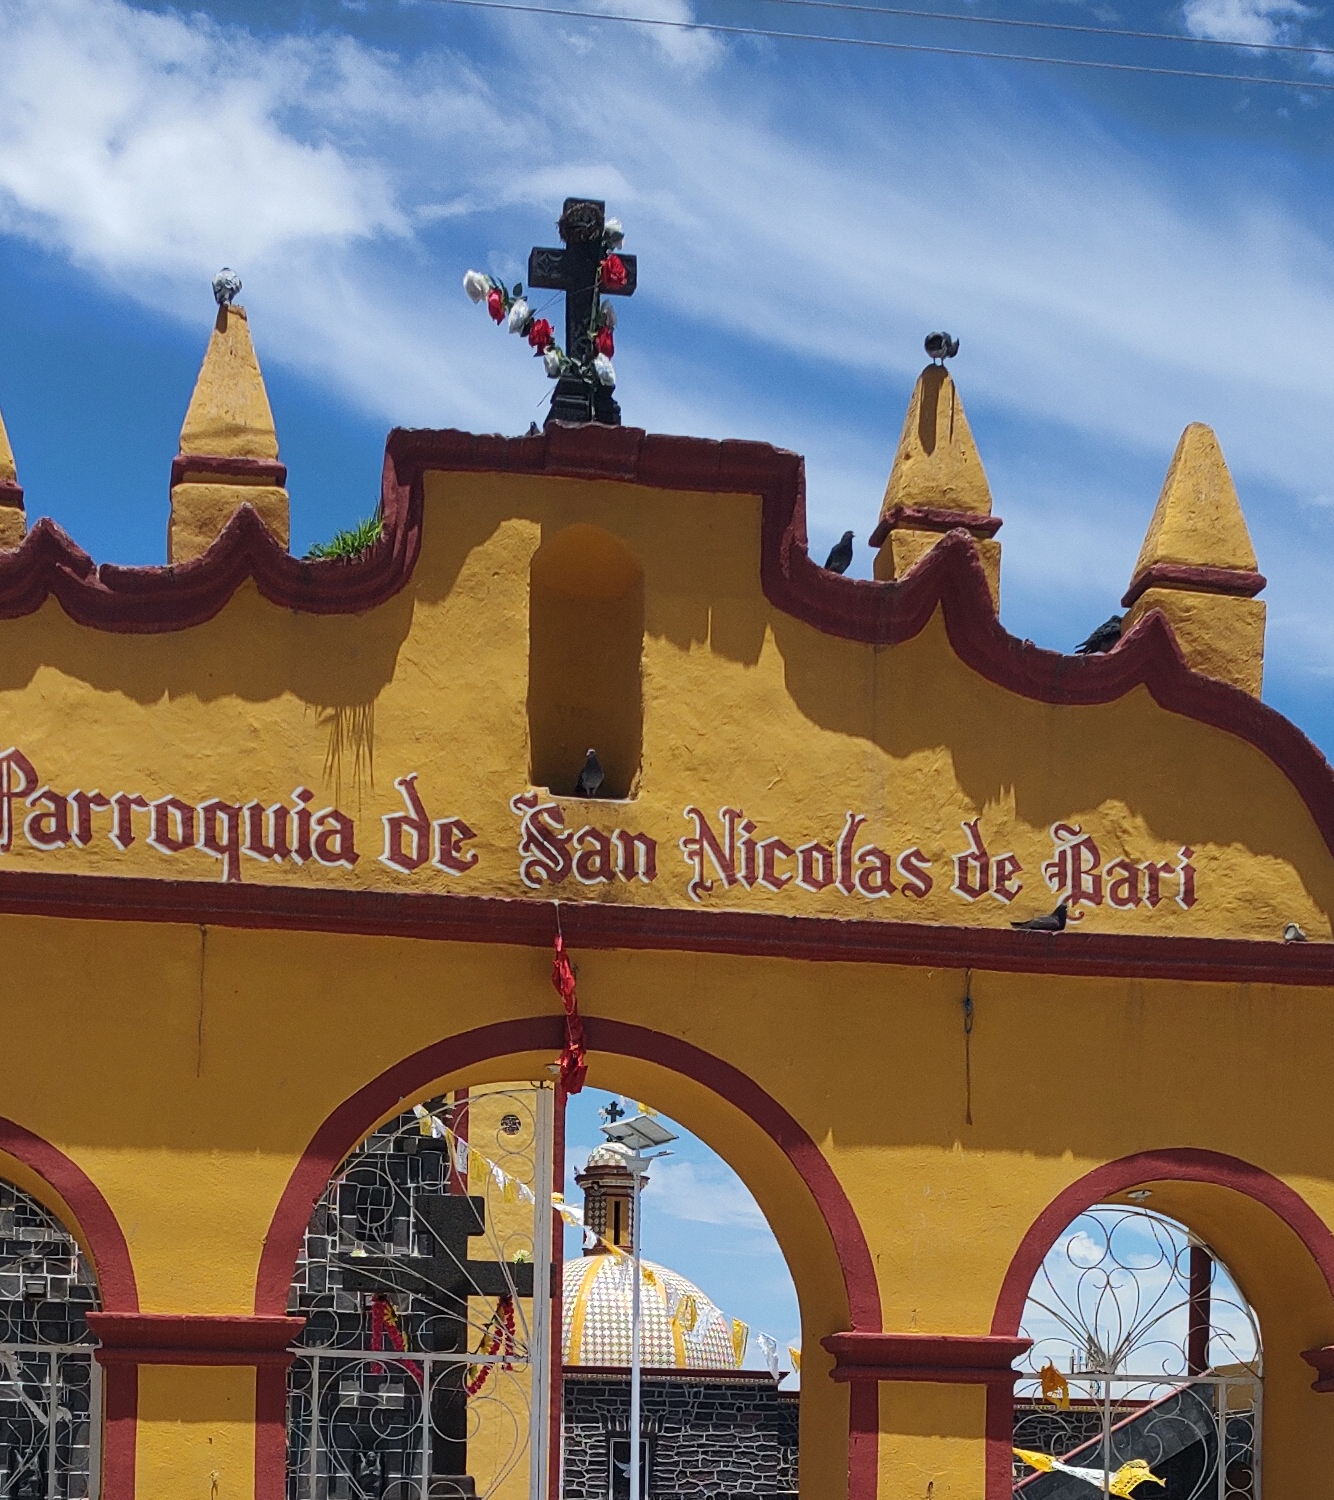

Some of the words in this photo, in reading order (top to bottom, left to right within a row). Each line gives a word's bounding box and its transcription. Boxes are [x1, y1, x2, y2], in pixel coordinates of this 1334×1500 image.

[379, 773, 479, 877] de
[510, 791, 659, 890] San
[681, 805, 935, 902] Nicolas
[952, 816, 1024, 904] de
[1041, 821, 1199, 924] Bari
